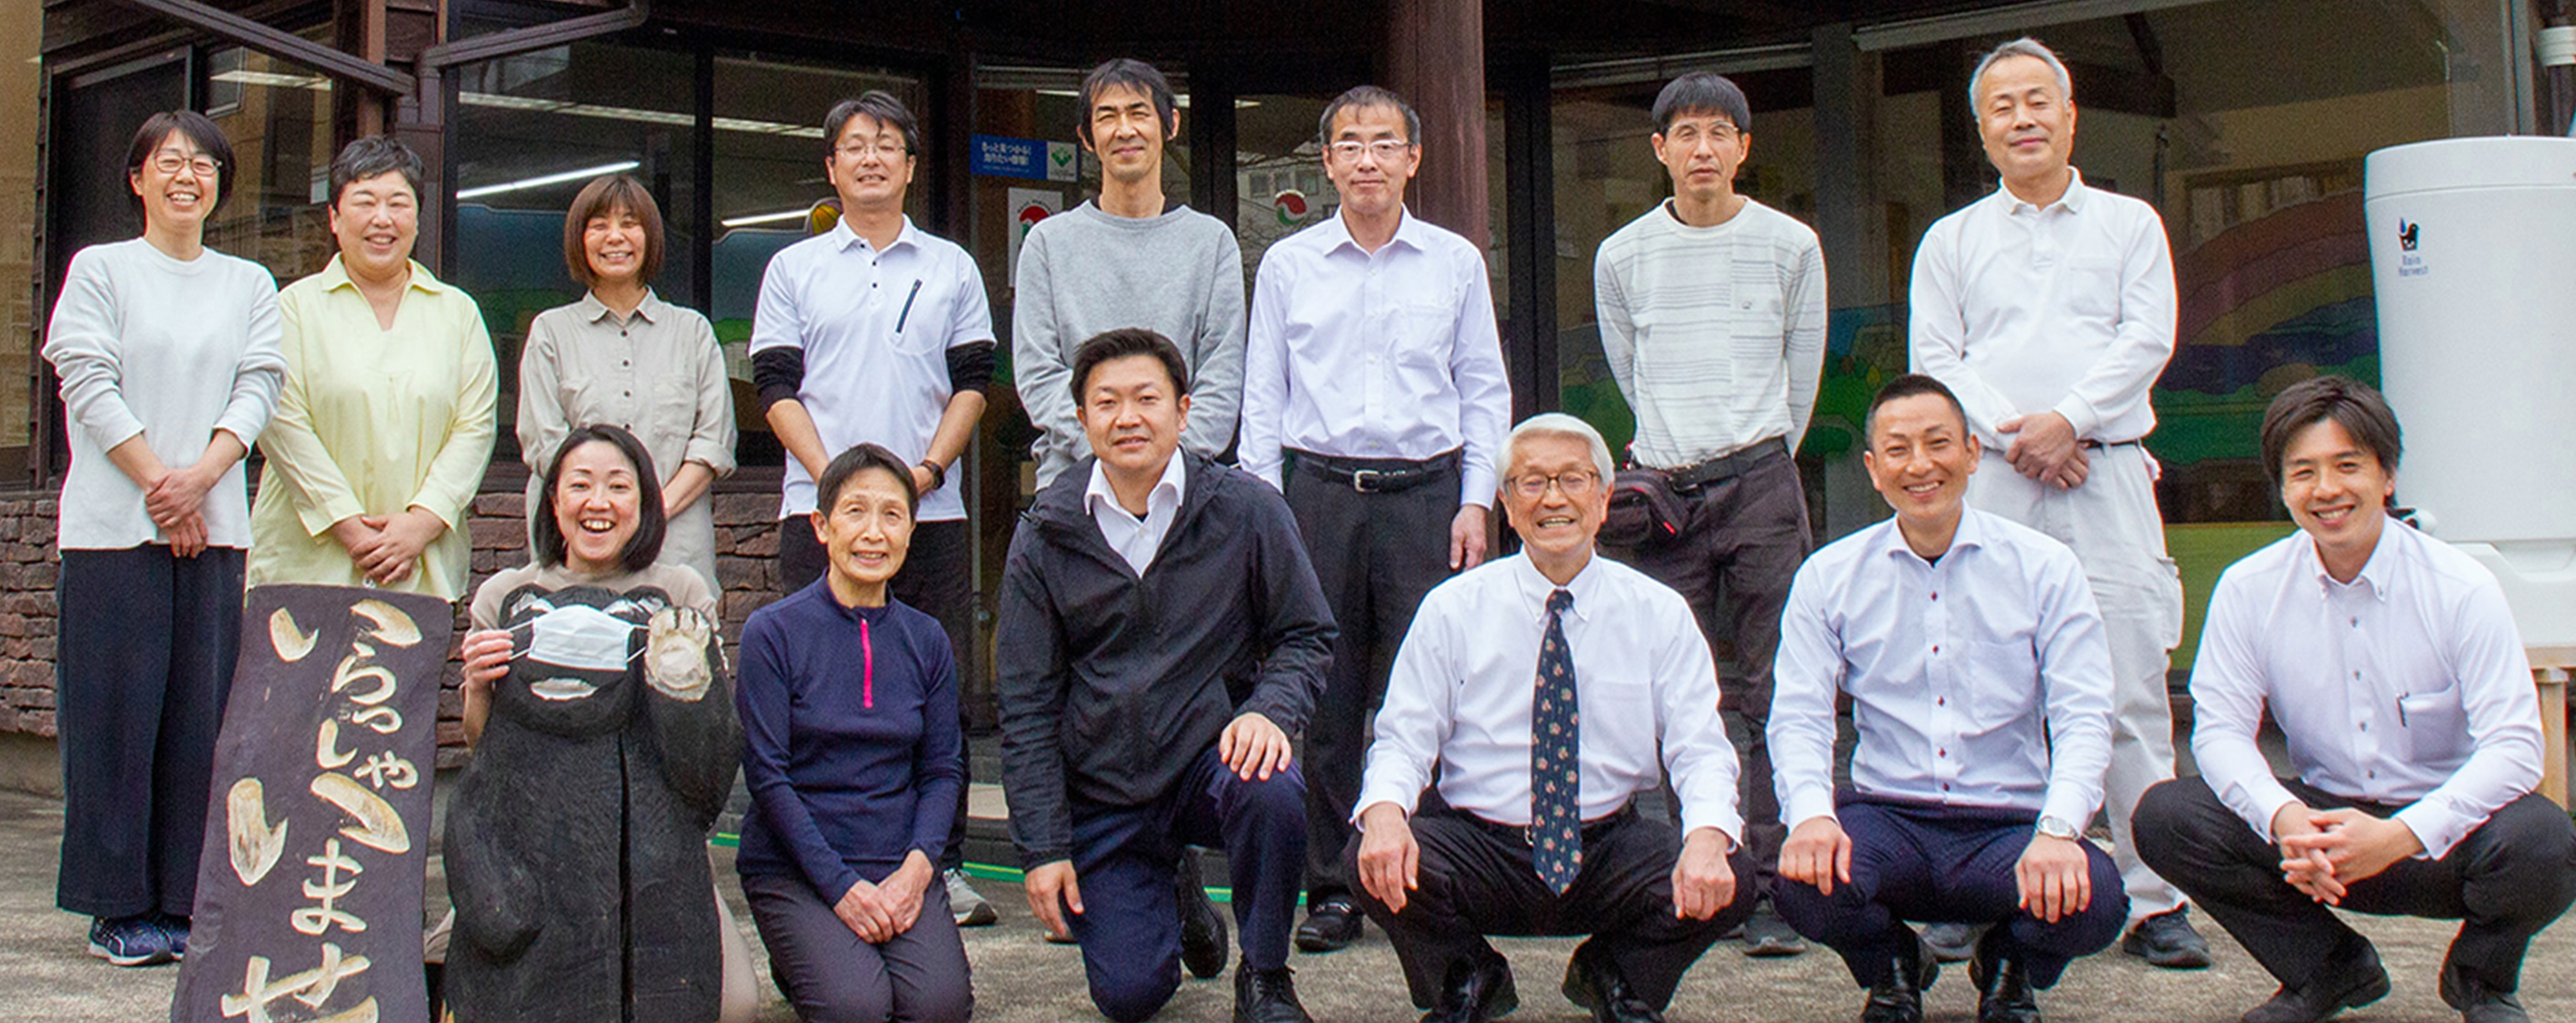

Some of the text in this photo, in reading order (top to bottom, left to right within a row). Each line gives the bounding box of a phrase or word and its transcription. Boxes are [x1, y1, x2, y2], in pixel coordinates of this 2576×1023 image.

[2402, 255, 2421, 266] Rain
[2398, 265, 2429, 277] Harvest
[221, 598, 421, 1023] いらっしゃいませ
